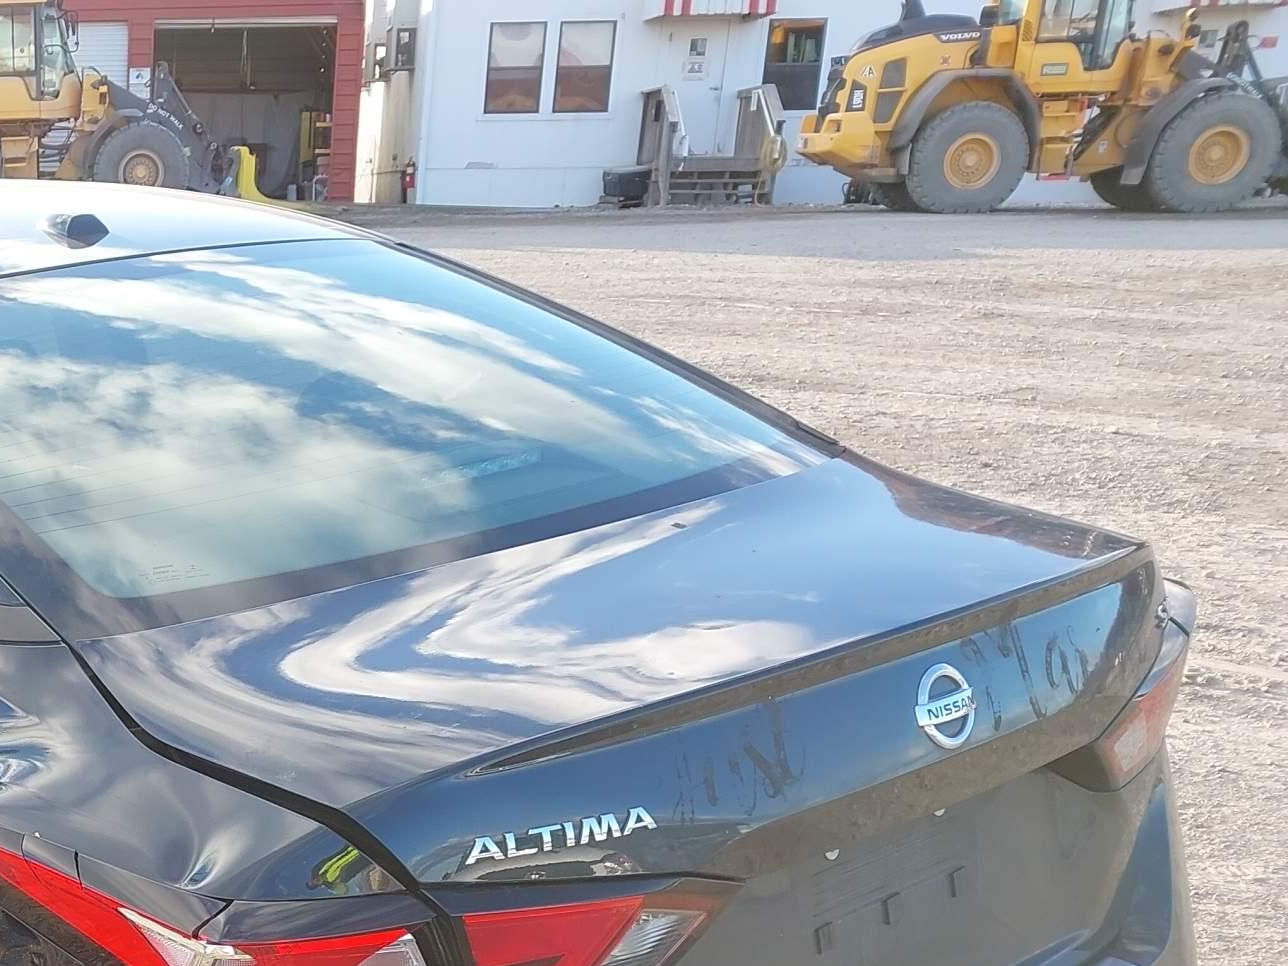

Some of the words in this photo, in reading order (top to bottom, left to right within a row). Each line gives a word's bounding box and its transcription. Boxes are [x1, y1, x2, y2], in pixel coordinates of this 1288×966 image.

[939, 31, 981, 41] VOLVO
[158, 107, 170, 118] NOT
[169, 114, 184, 130] WALK
[926, 693, 976, 721] NISSAN
[464, 805, 659, 866] ALTIMA
